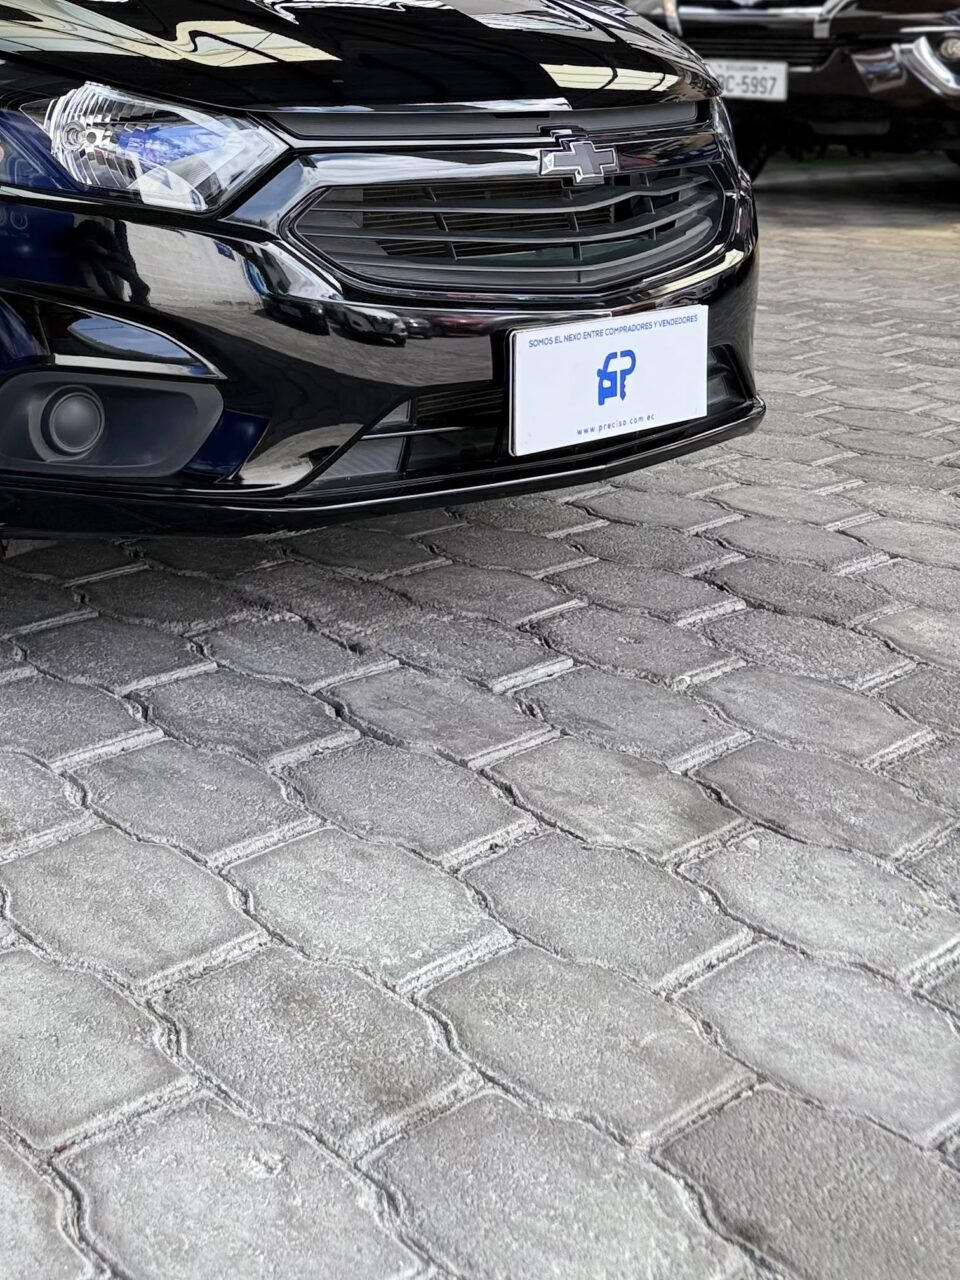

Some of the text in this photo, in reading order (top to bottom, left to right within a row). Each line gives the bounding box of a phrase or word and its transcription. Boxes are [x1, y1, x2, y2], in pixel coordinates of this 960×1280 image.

[528, 337, 553, 348] SOMOS
[554, 335, 562, 344] EL
[563, 333, 581, 342] NEXO
[583, 329, 603, 339] ENTRE
[605, 321, 652, 336] COMPRADORES
[659, 314, 698, 327] VENDEDORES
